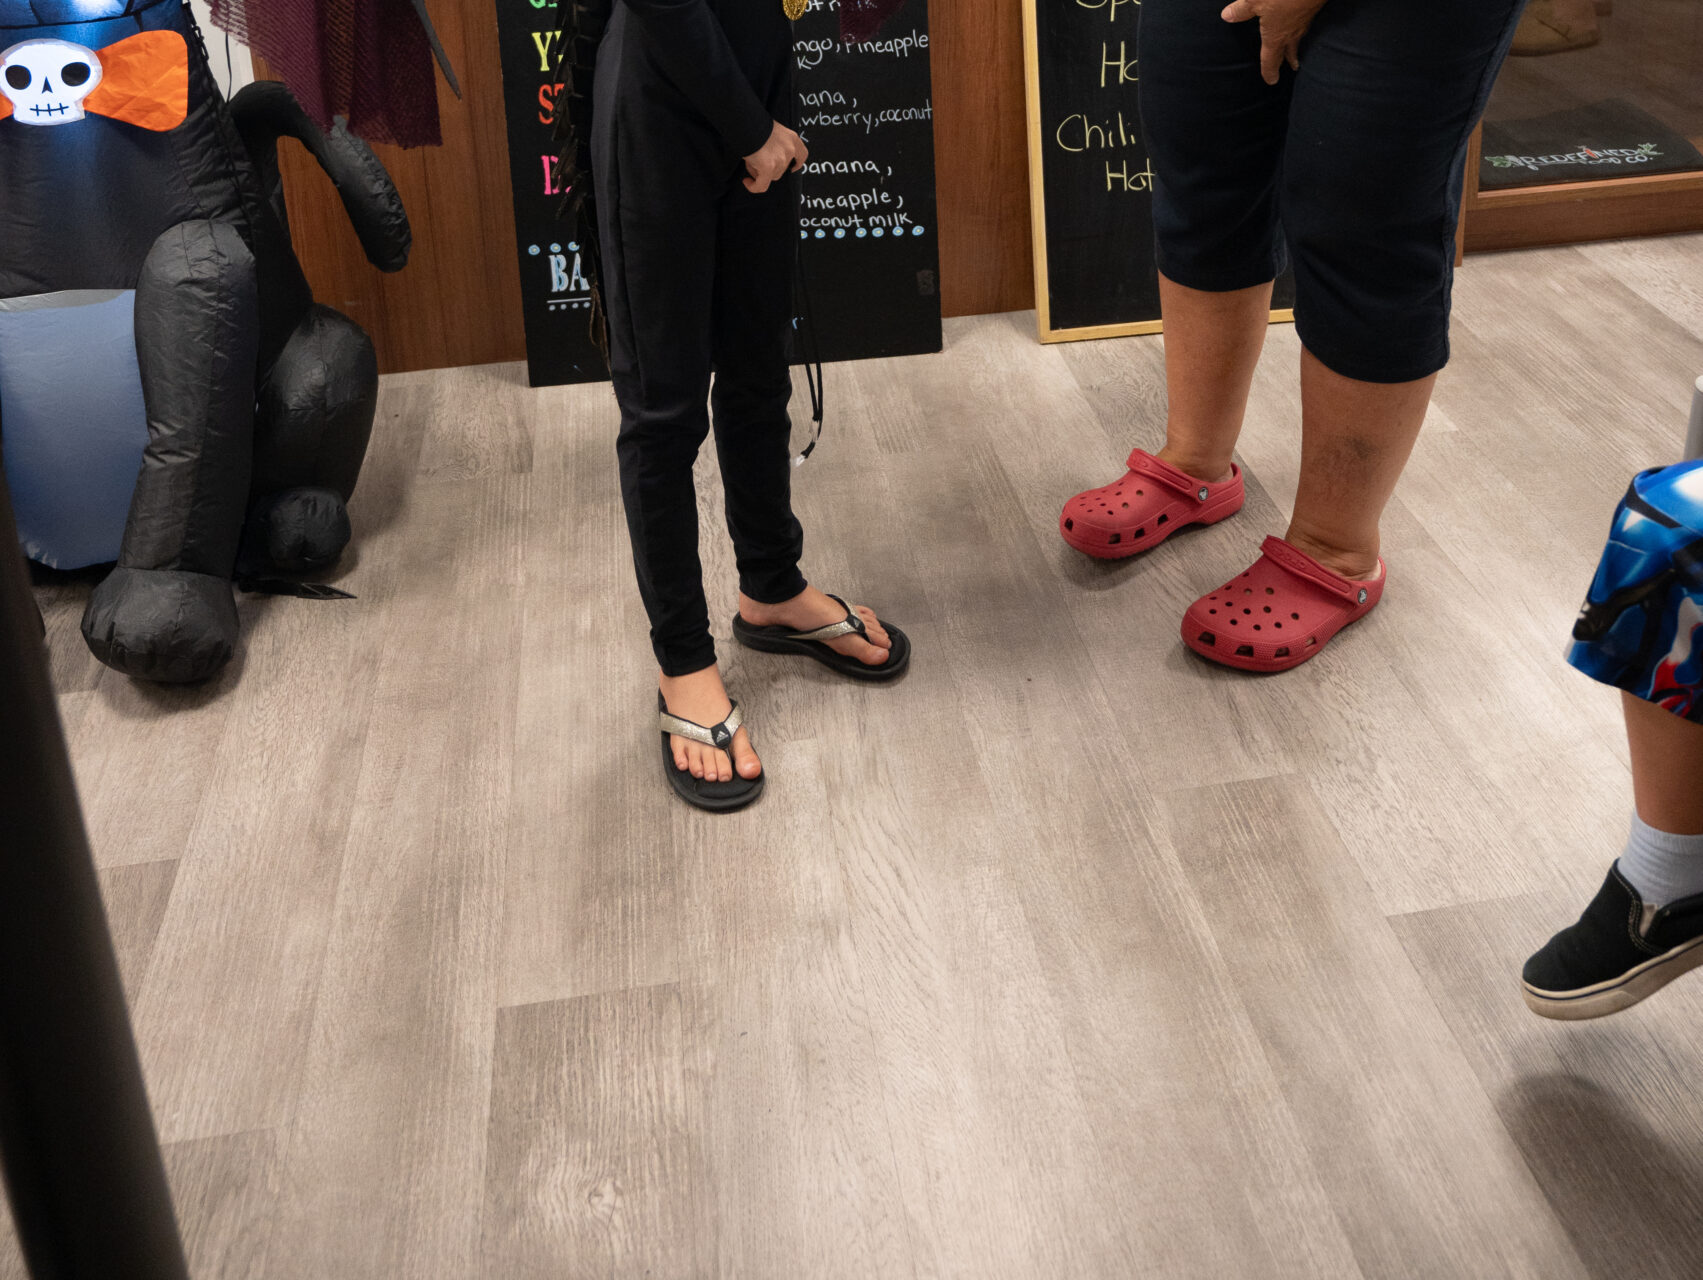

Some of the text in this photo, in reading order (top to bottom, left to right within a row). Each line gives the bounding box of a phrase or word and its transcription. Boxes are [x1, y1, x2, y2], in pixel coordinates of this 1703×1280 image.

[1056, 112, 1137, 152] Chili
[800, 212, 914, 228] oconut milk
